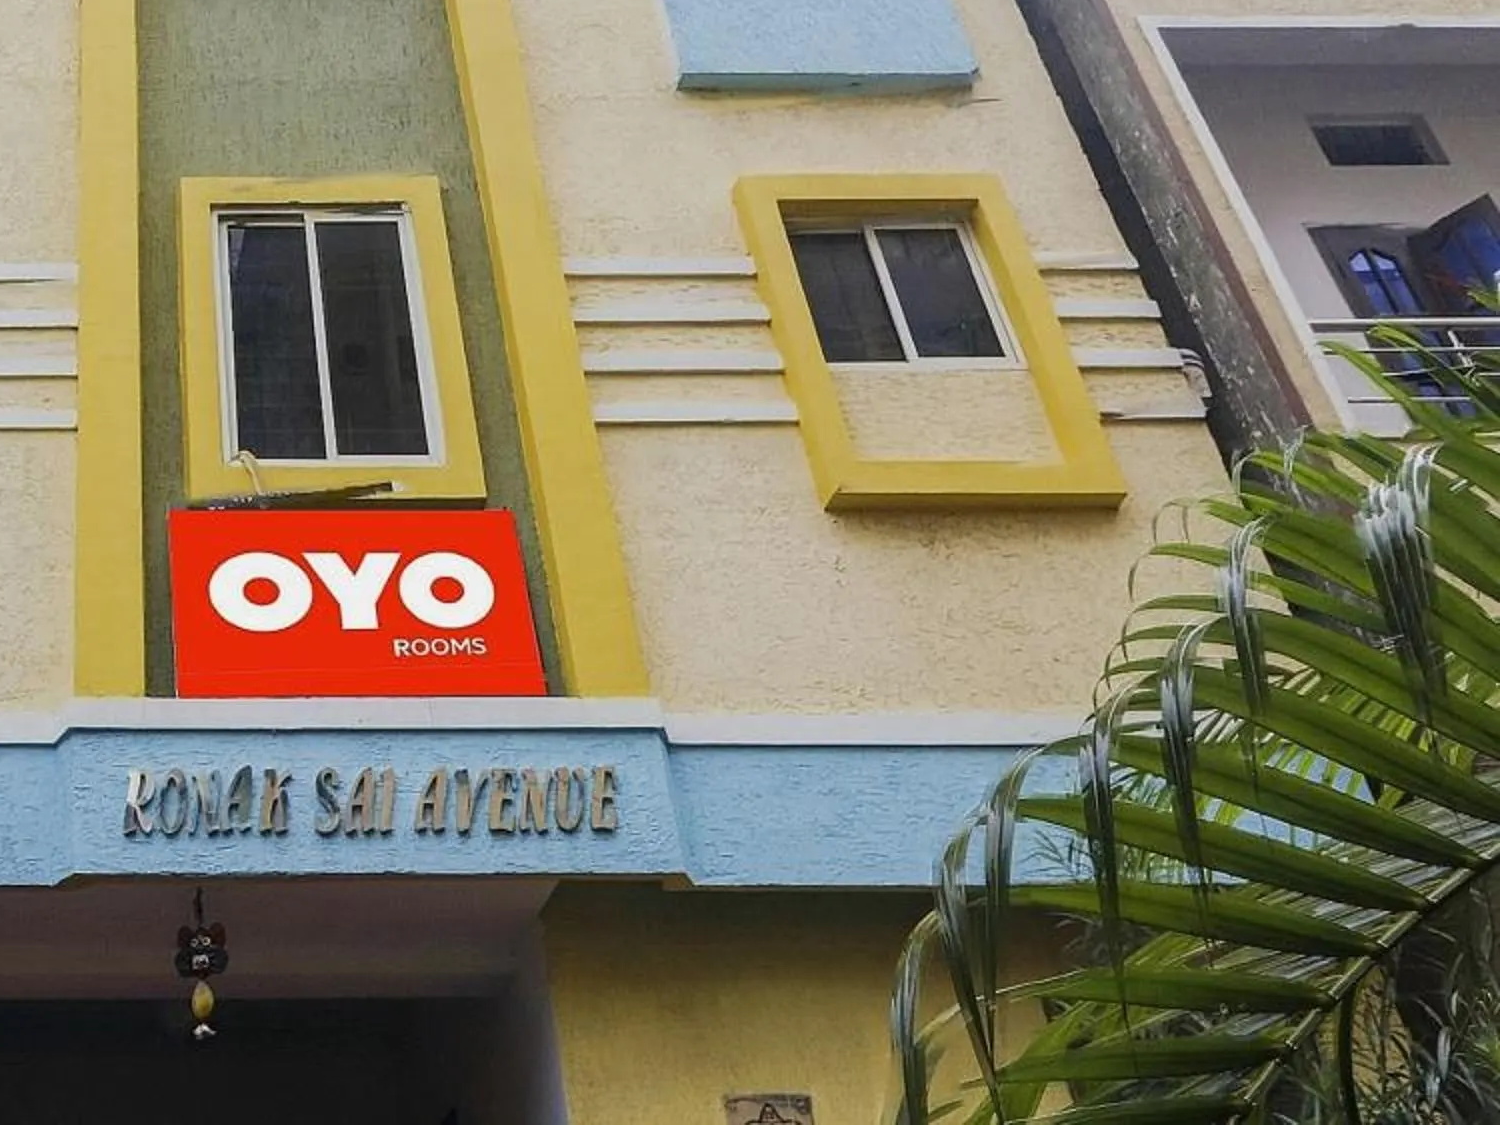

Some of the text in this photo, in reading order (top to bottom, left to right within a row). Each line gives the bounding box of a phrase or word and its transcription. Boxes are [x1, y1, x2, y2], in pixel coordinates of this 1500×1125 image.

[208, 550, 496, 633] OYO
[393, 636, 488, 658] ROOMS
[122, 763, 618, 839] RONAK SAI AVENUE
